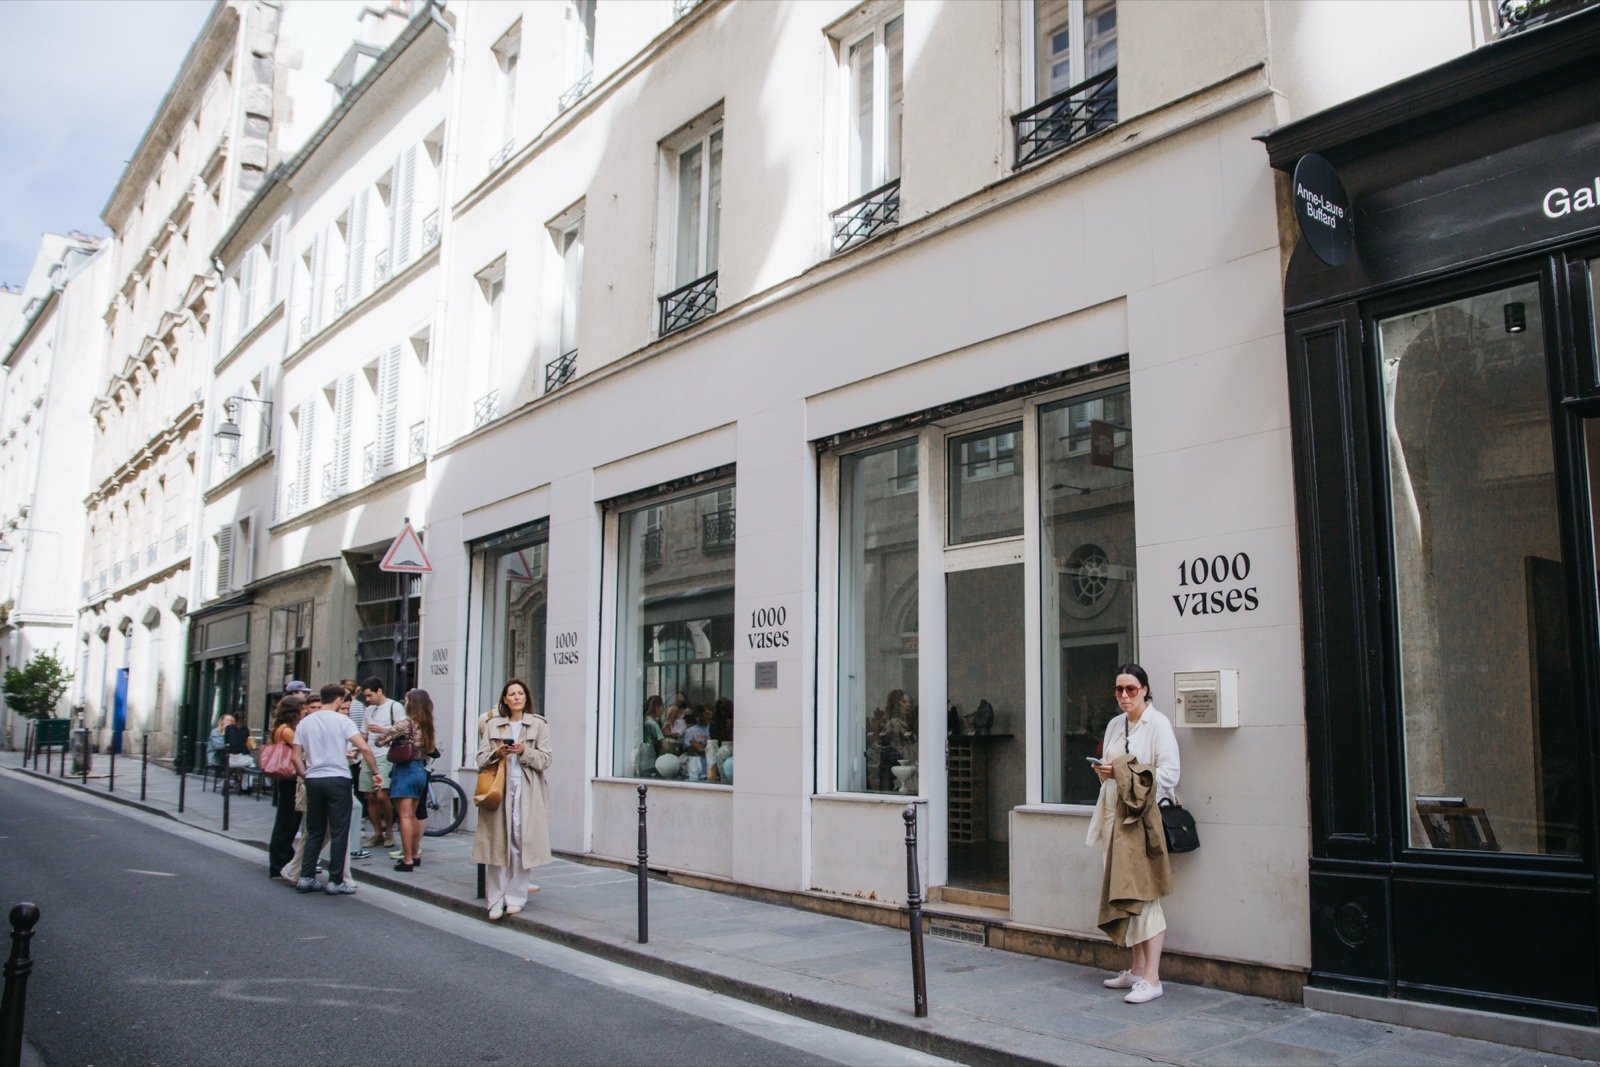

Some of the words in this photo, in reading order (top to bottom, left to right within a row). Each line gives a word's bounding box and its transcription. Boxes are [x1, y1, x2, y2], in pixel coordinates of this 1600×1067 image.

[1297, 183, 1344, 218] Anne-Laure
[1306, 202, 1336, 228] Buffard
[1178, 552, 1250, 586] 1000
[1172, 586, 1259, 617] vases
[751, 606, 786, 628] 1000
[555, 631, 577, 648] 1000
[748, 630, 789, 648] vases
[553, 650, 579, 664] vases
